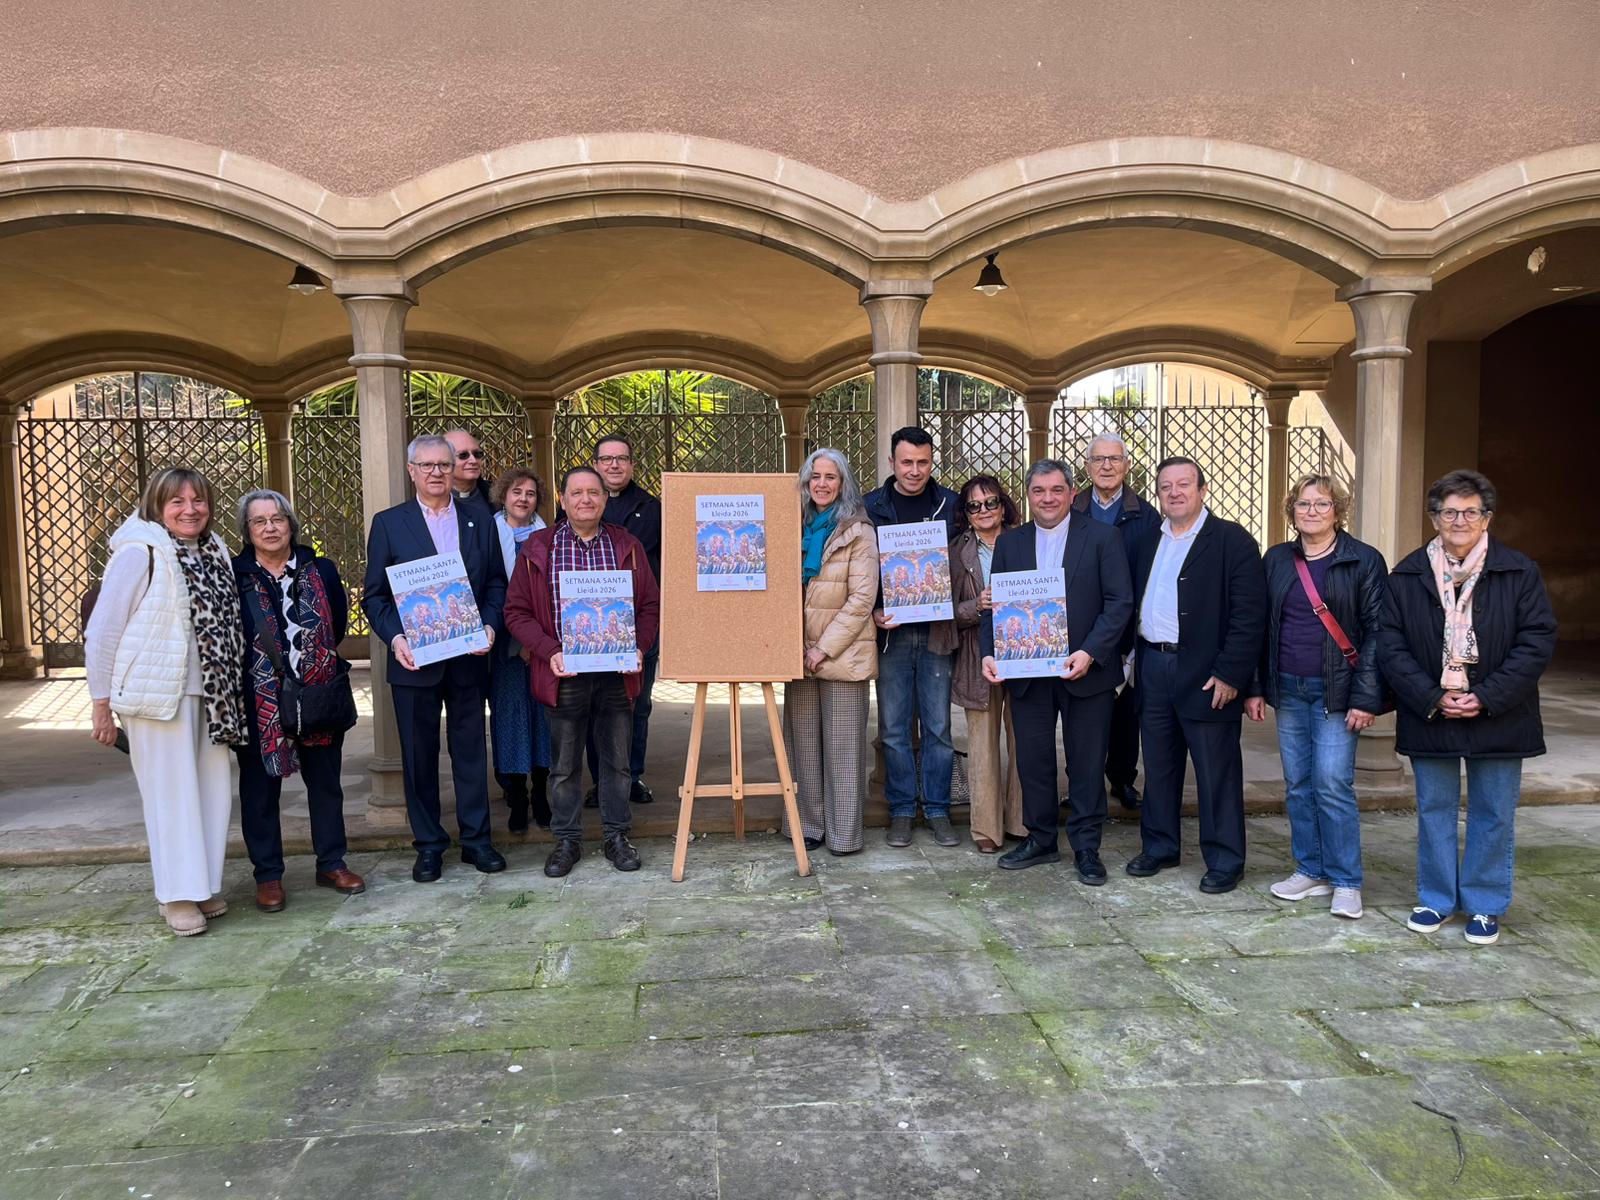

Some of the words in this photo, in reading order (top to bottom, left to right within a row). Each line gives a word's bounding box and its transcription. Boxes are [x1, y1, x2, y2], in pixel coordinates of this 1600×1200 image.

[883, 530, 917, 539] SETMANA
[918, 528, 942, 536] SANTA
[916, 538, 932, 546] 2026
[394, 565, 431, 579] SETMANA
[432, 558, 458, 569] SANTA
[408, 575, 430, 585] Lleida
[432, 570, 449, 580] 2026
[996, 578, 1032, 588] SETMANA
[1034, 576, 1059, 584] SANTA
[1031, 587, 1048, 595] 2026
